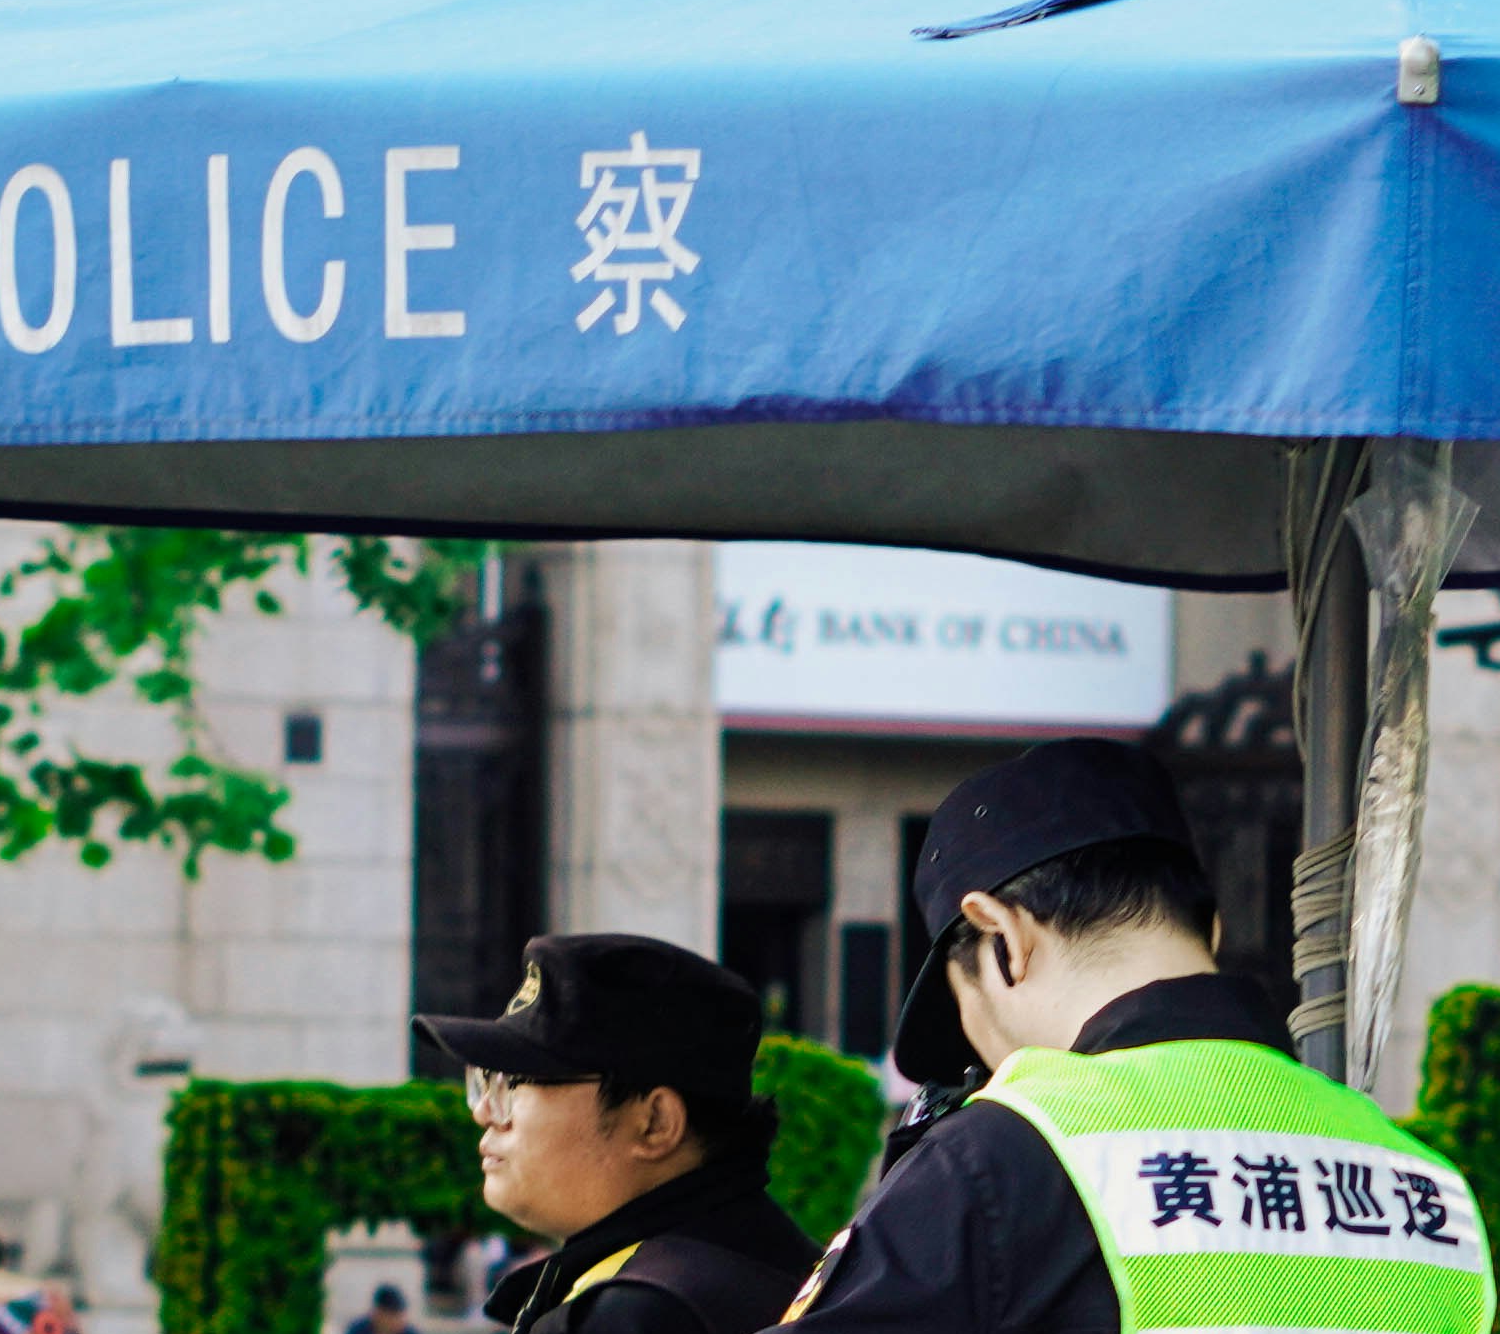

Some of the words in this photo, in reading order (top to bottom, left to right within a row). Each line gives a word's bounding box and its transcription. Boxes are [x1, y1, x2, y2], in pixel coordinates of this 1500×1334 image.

[568, 129, 703, 337] 察
[818, 609, 922, 647] BANK
[936, 617, 984, 651] OF
[1000, 617, 1128, 657] CHINA
[1137, 1151, 1460, 1247] 黄浦巡逻
